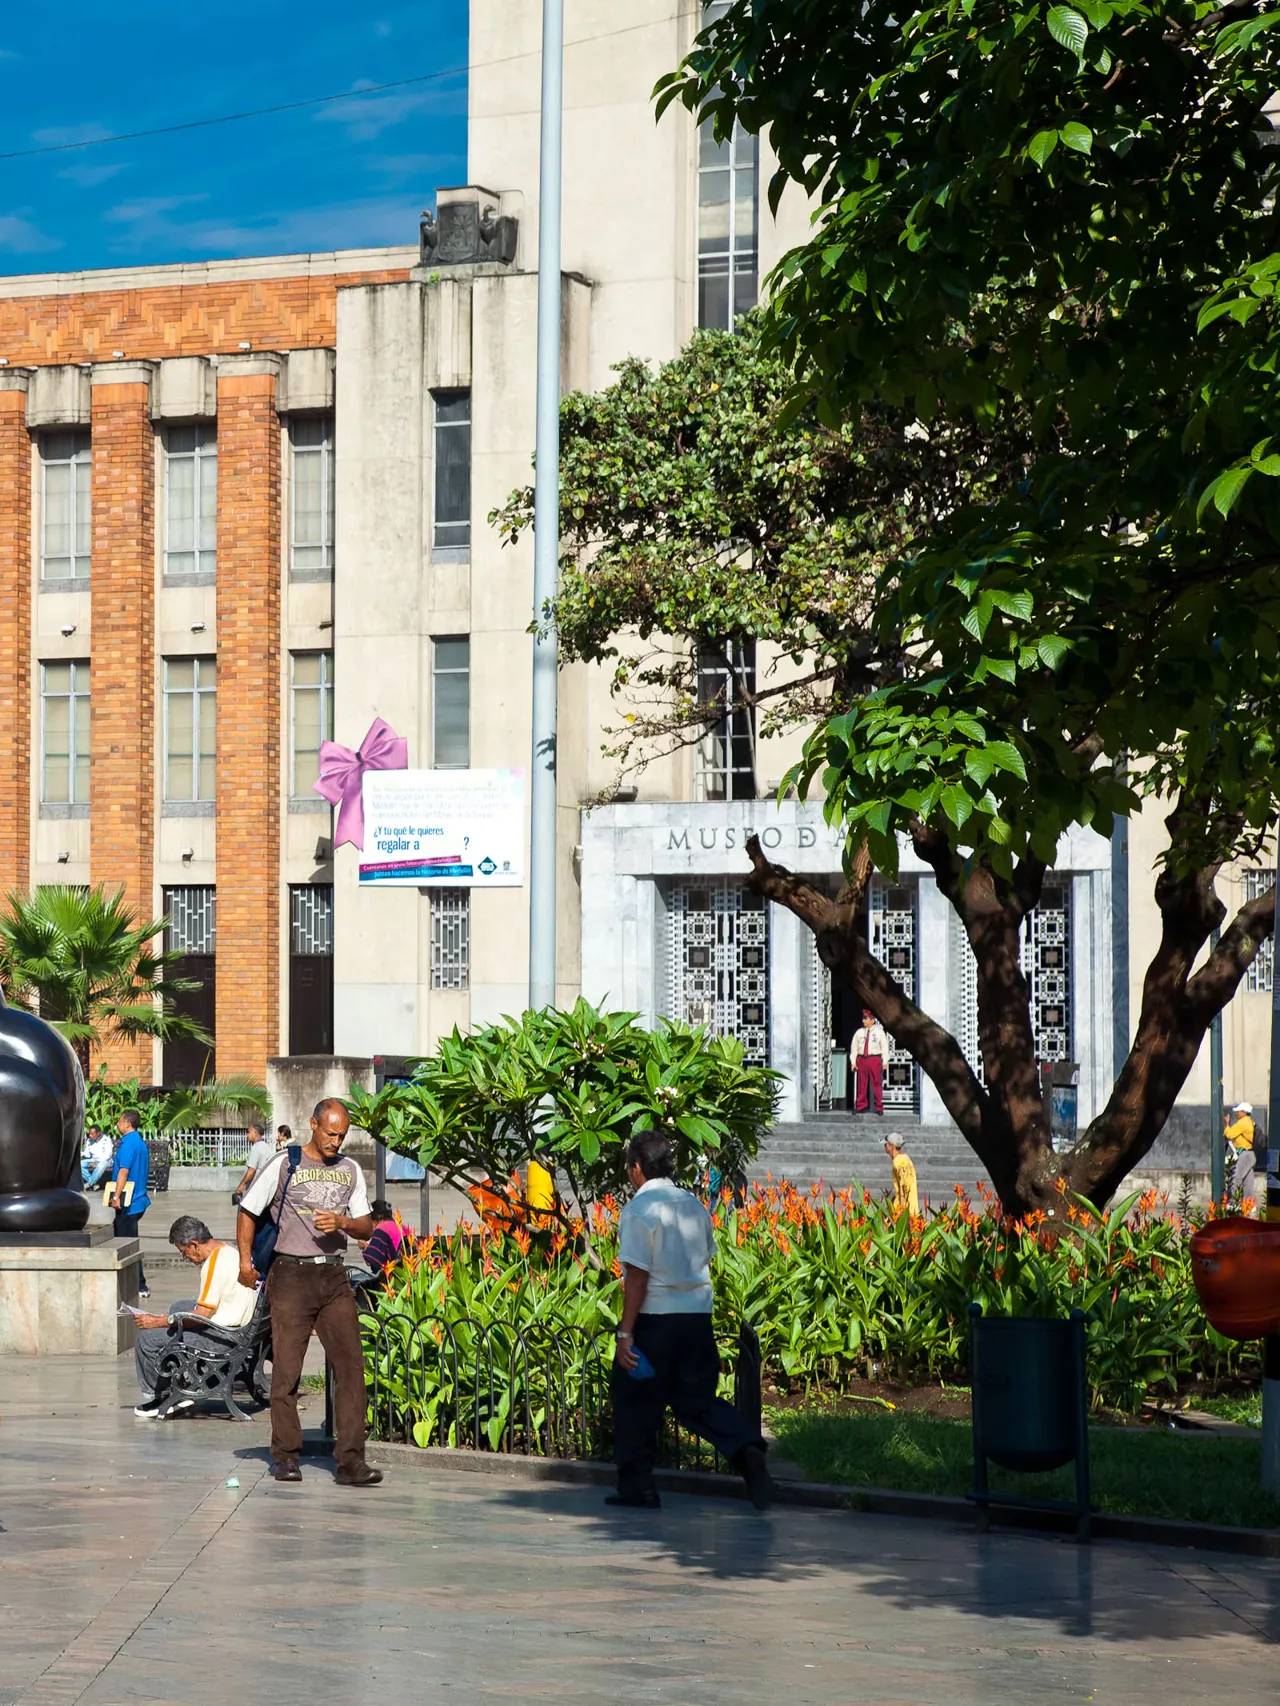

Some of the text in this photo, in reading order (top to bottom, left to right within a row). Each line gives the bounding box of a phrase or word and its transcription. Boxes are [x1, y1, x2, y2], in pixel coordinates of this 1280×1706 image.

[373, 826, 382, 838] ¿Y
[393, 826, 407, 837] qué
[408, 826, 416, 835] le
[417, 826, 444, 837] quieres
[377, 837, 411, 854] regalar
[413, 840, 420, 850] a
[392, 869, 415, 877] hacemos
